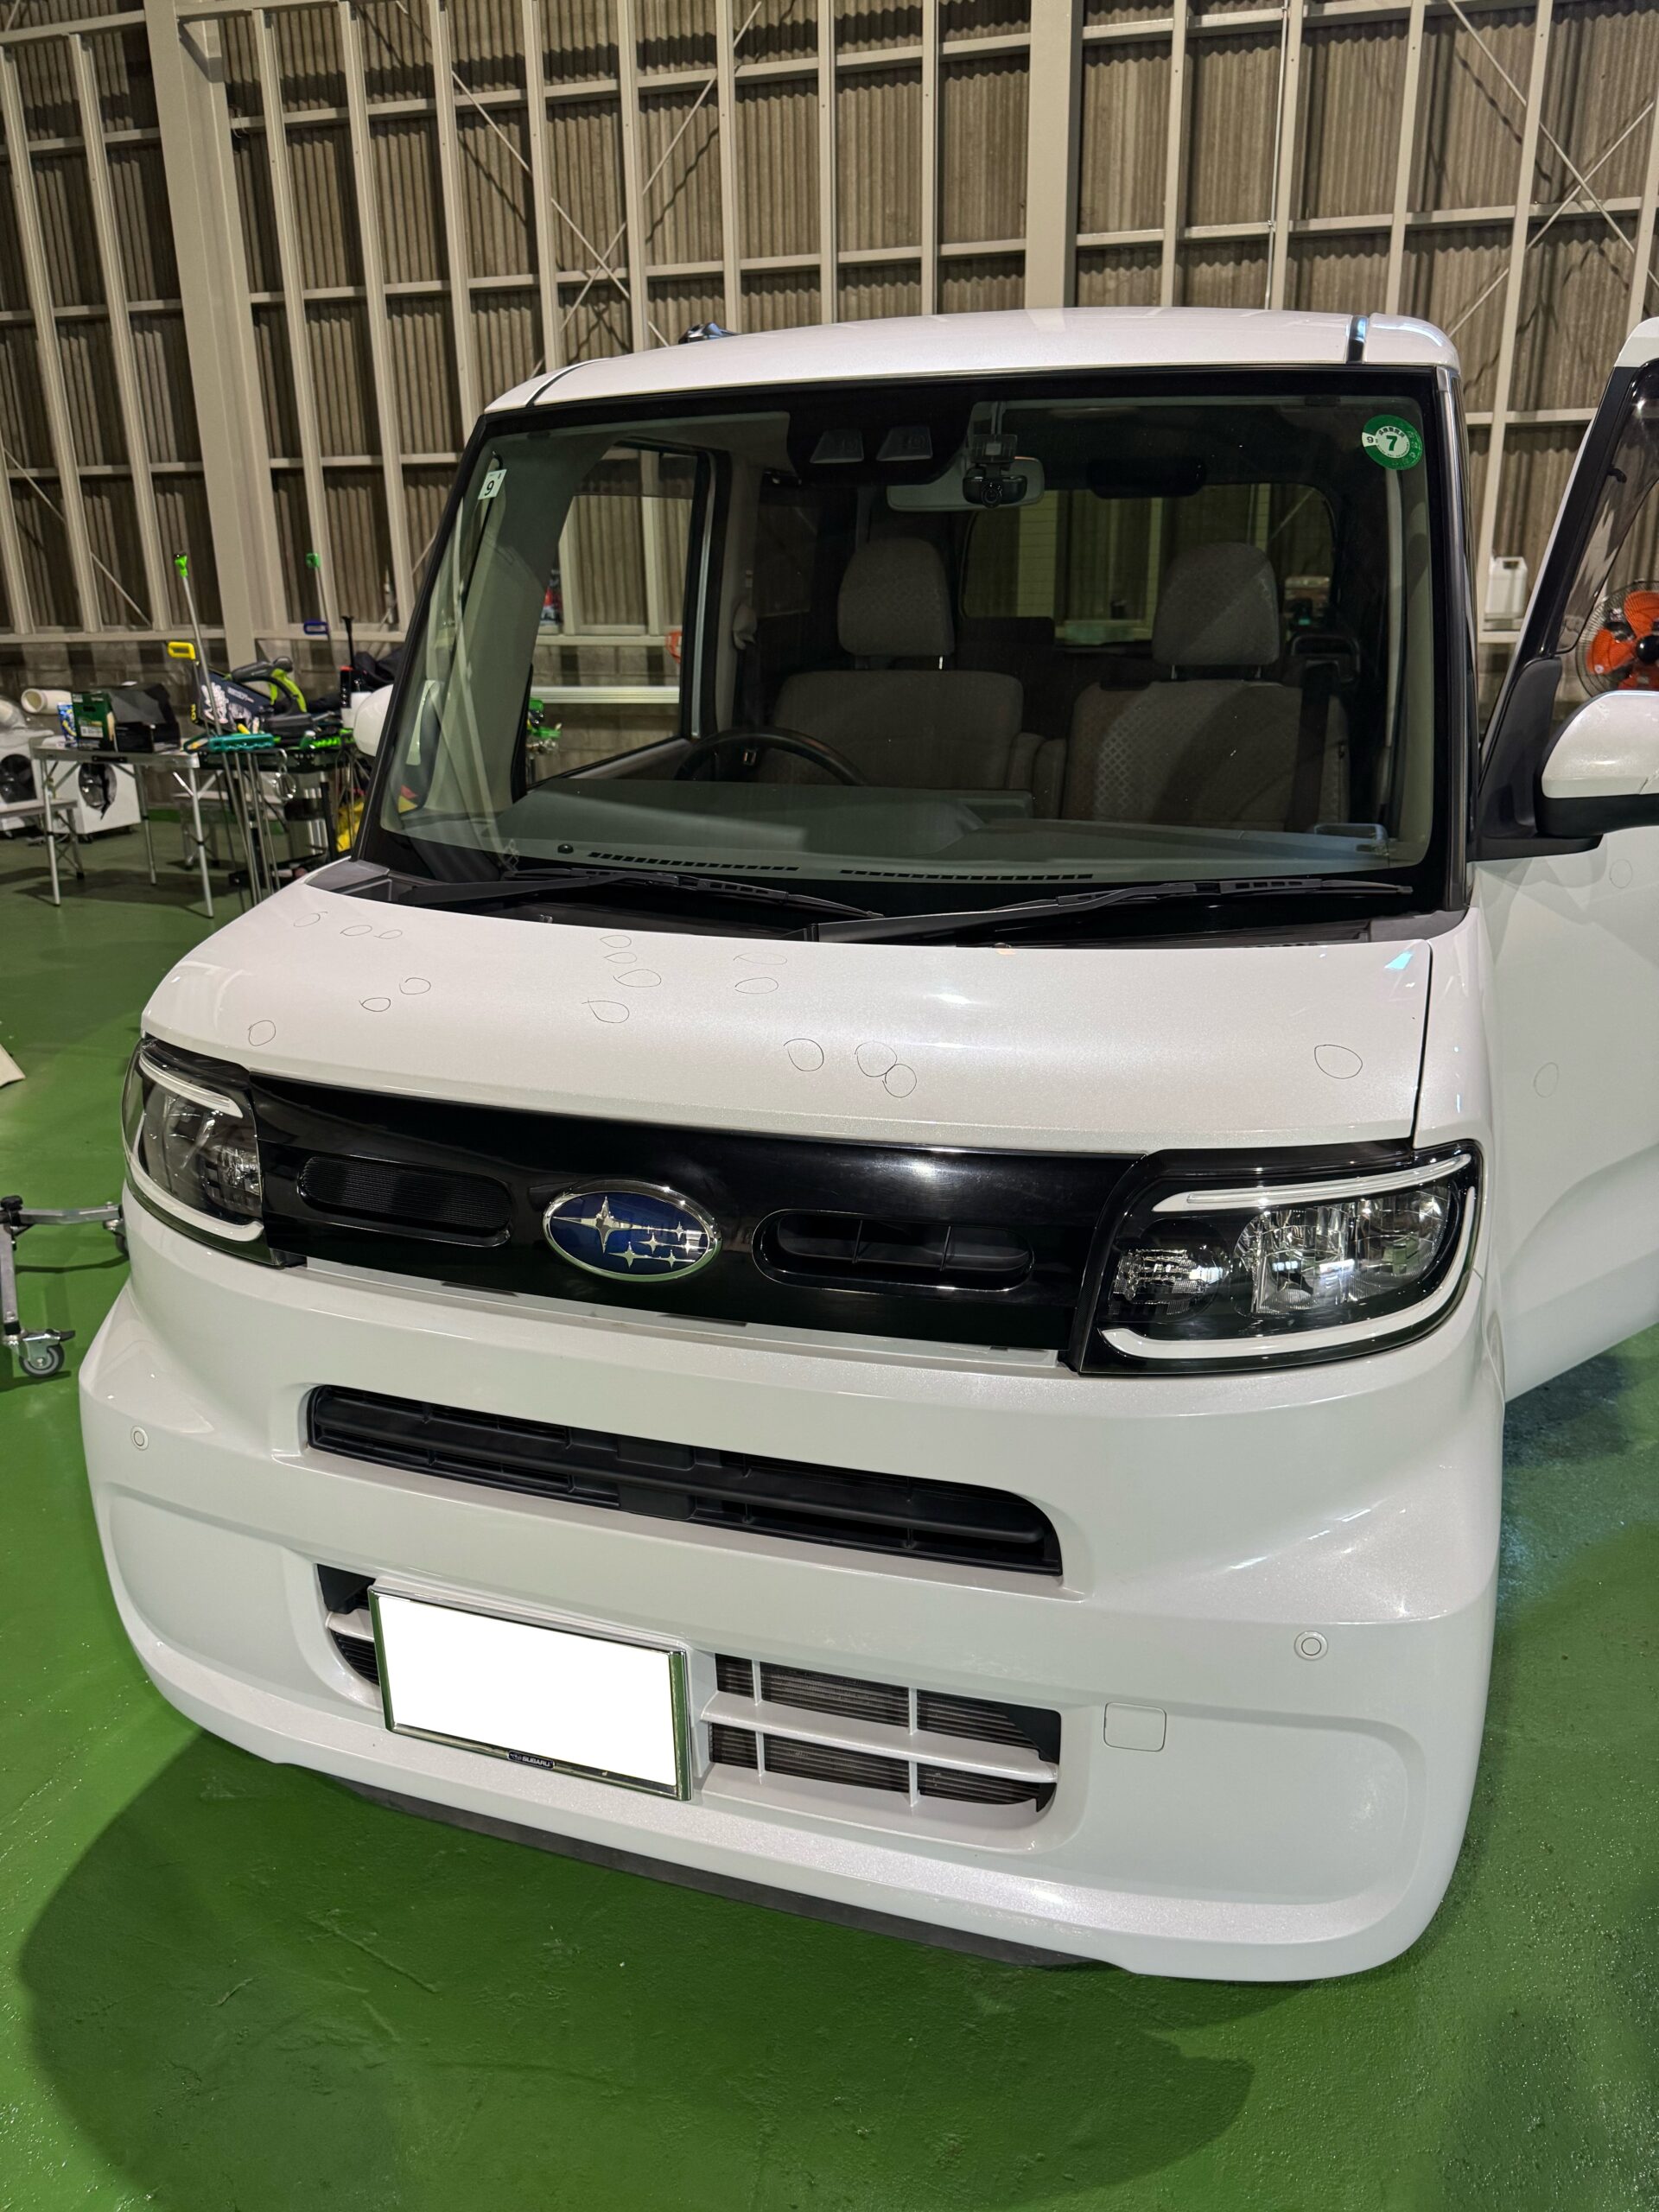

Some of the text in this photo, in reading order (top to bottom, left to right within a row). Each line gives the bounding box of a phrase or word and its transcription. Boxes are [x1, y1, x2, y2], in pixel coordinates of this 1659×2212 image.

[1386, 435, 1397, 451] 7
[484, 480, 495, 496] 9
[522, 1756, 550, 1766] SUBARU
